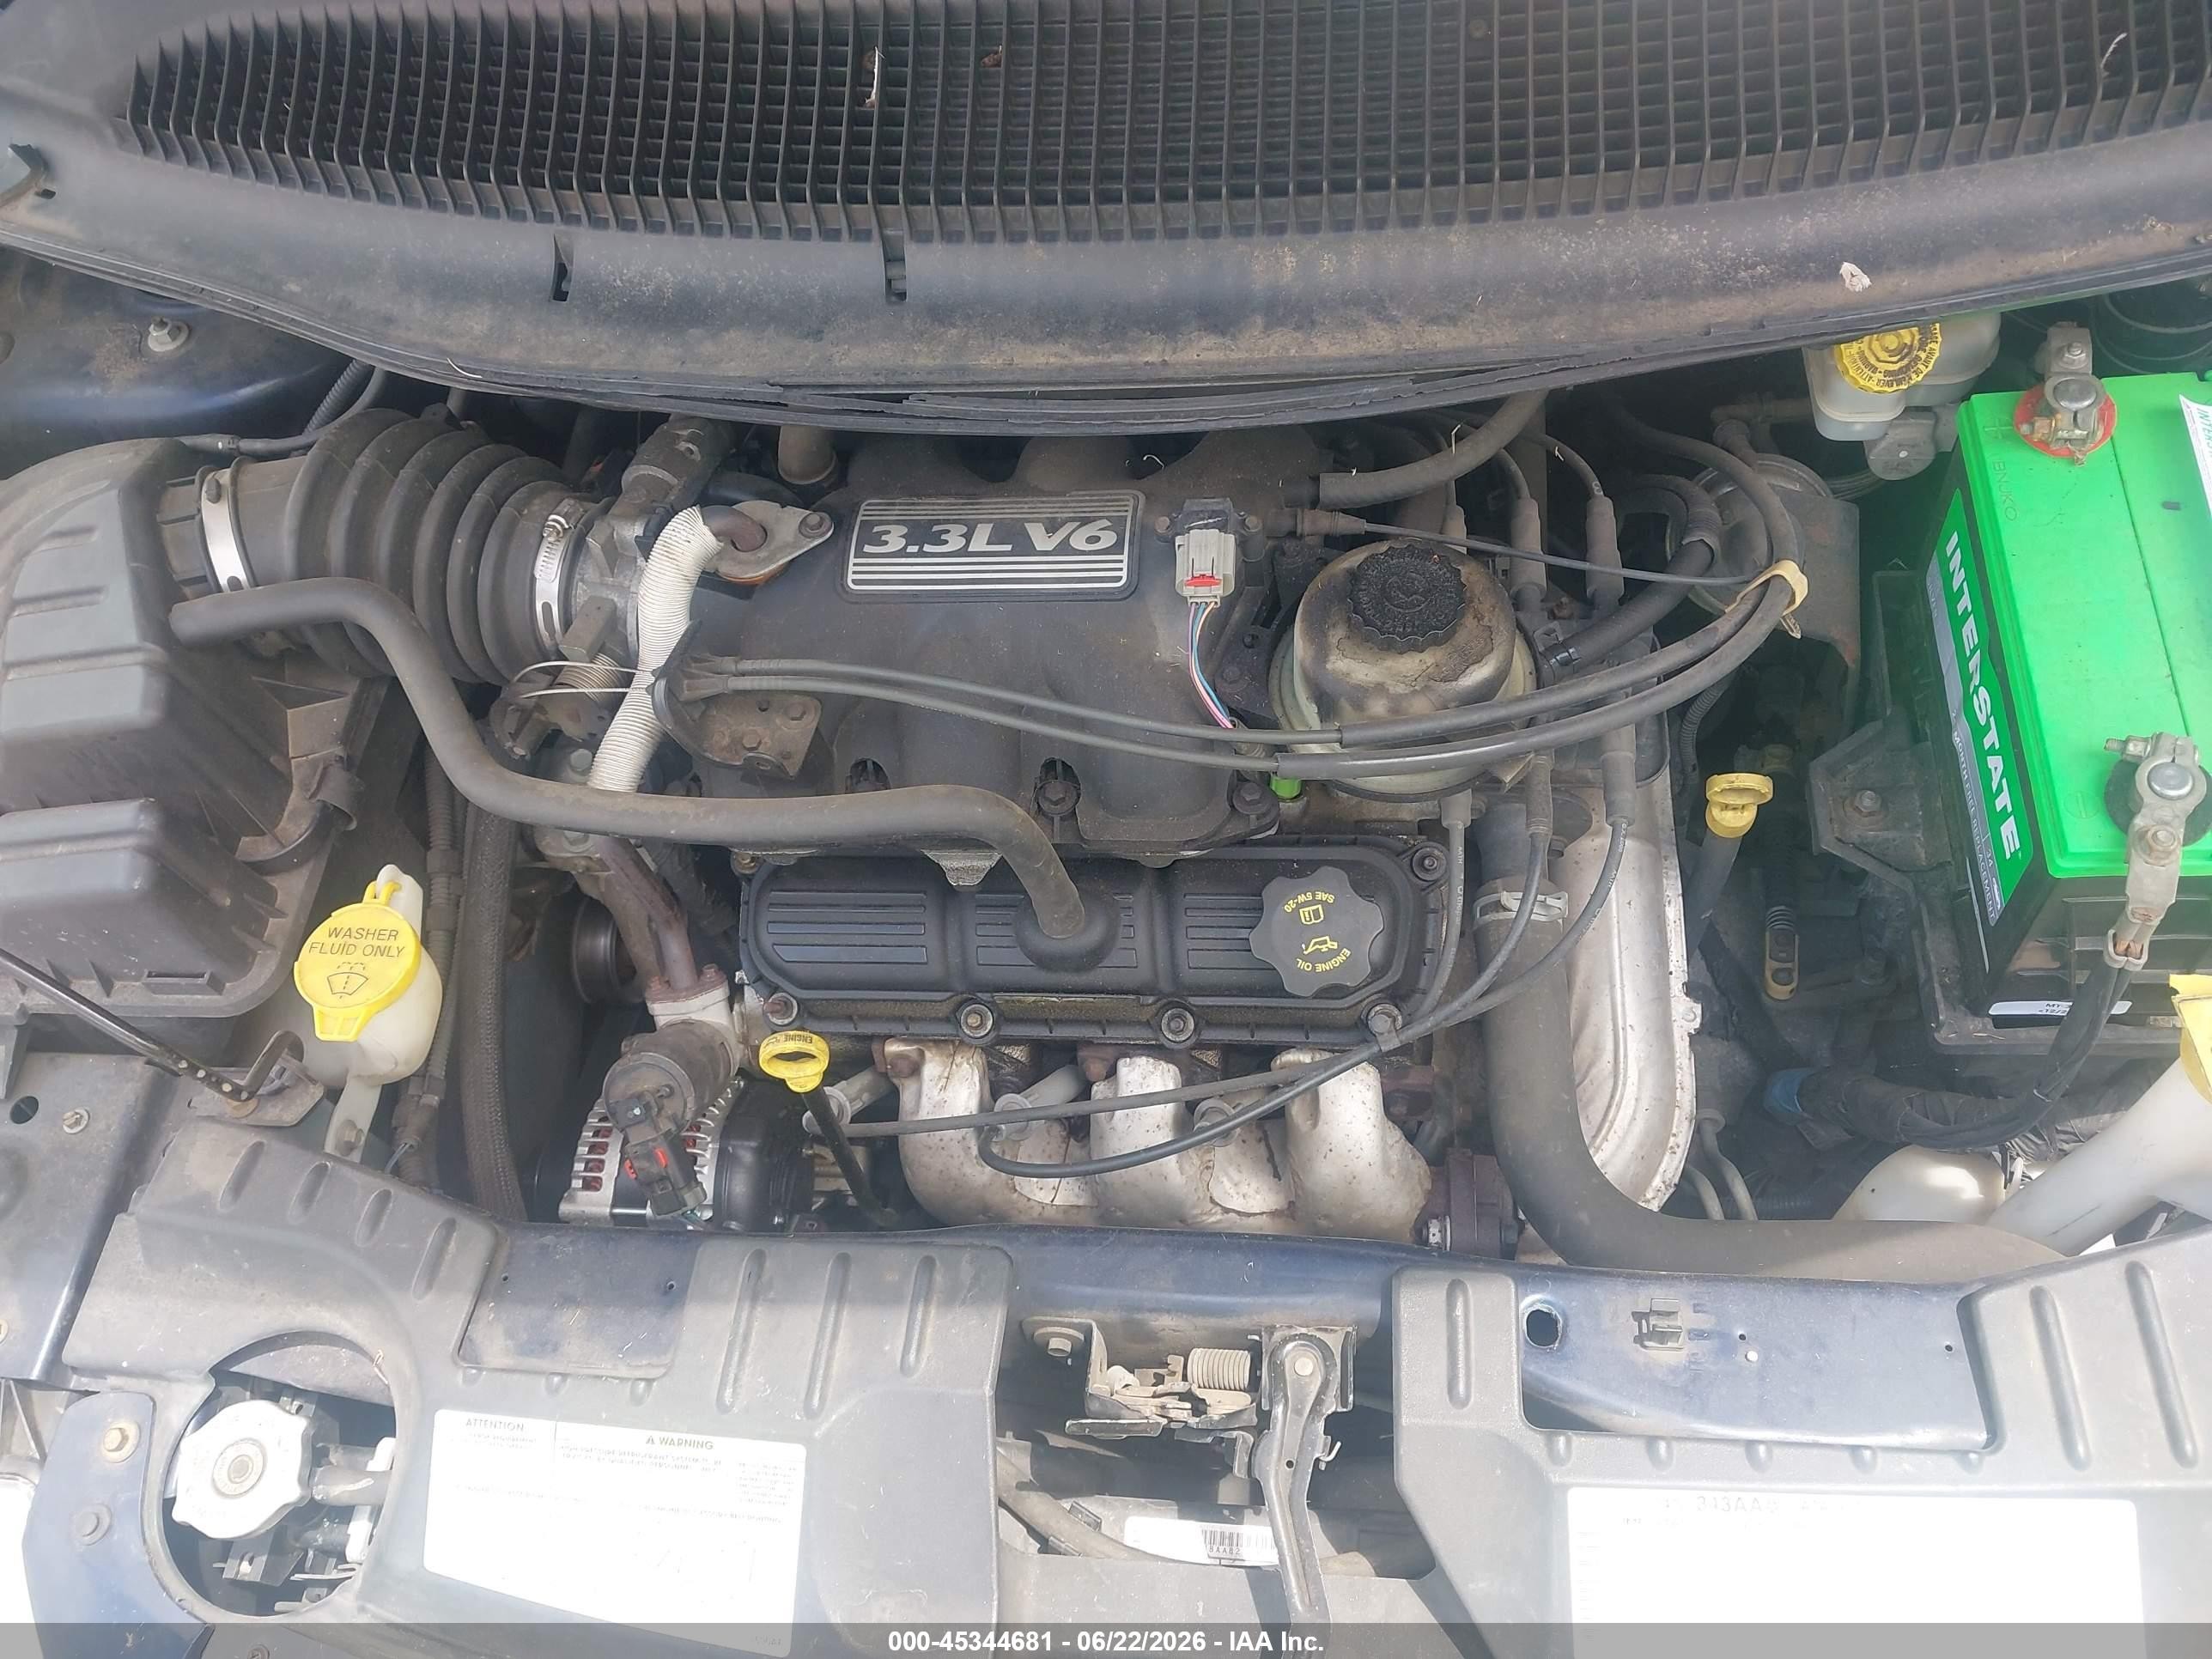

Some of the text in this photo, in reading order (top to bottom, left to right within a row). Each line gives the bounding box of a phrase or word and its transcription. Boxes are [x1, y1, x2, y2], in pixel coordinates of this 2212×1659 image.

[862, 519, 1118, 553] 3.3L V6
[1945, 531, 2021, 860] INTERSTATE
[1284, 891, 1335, 913] SAE 5W-20
[327, 927, 399, 941] WASHER
[308, 941, 405, 957] FLUID ONLY
[1296, 948, 1352, 973] ENGINE OIL
[782, 1033, 813, 1044] ENGINE
[465, 1418, 525, 1433] ATTENTION
[659, 1437, 714, 1450] WARNING
